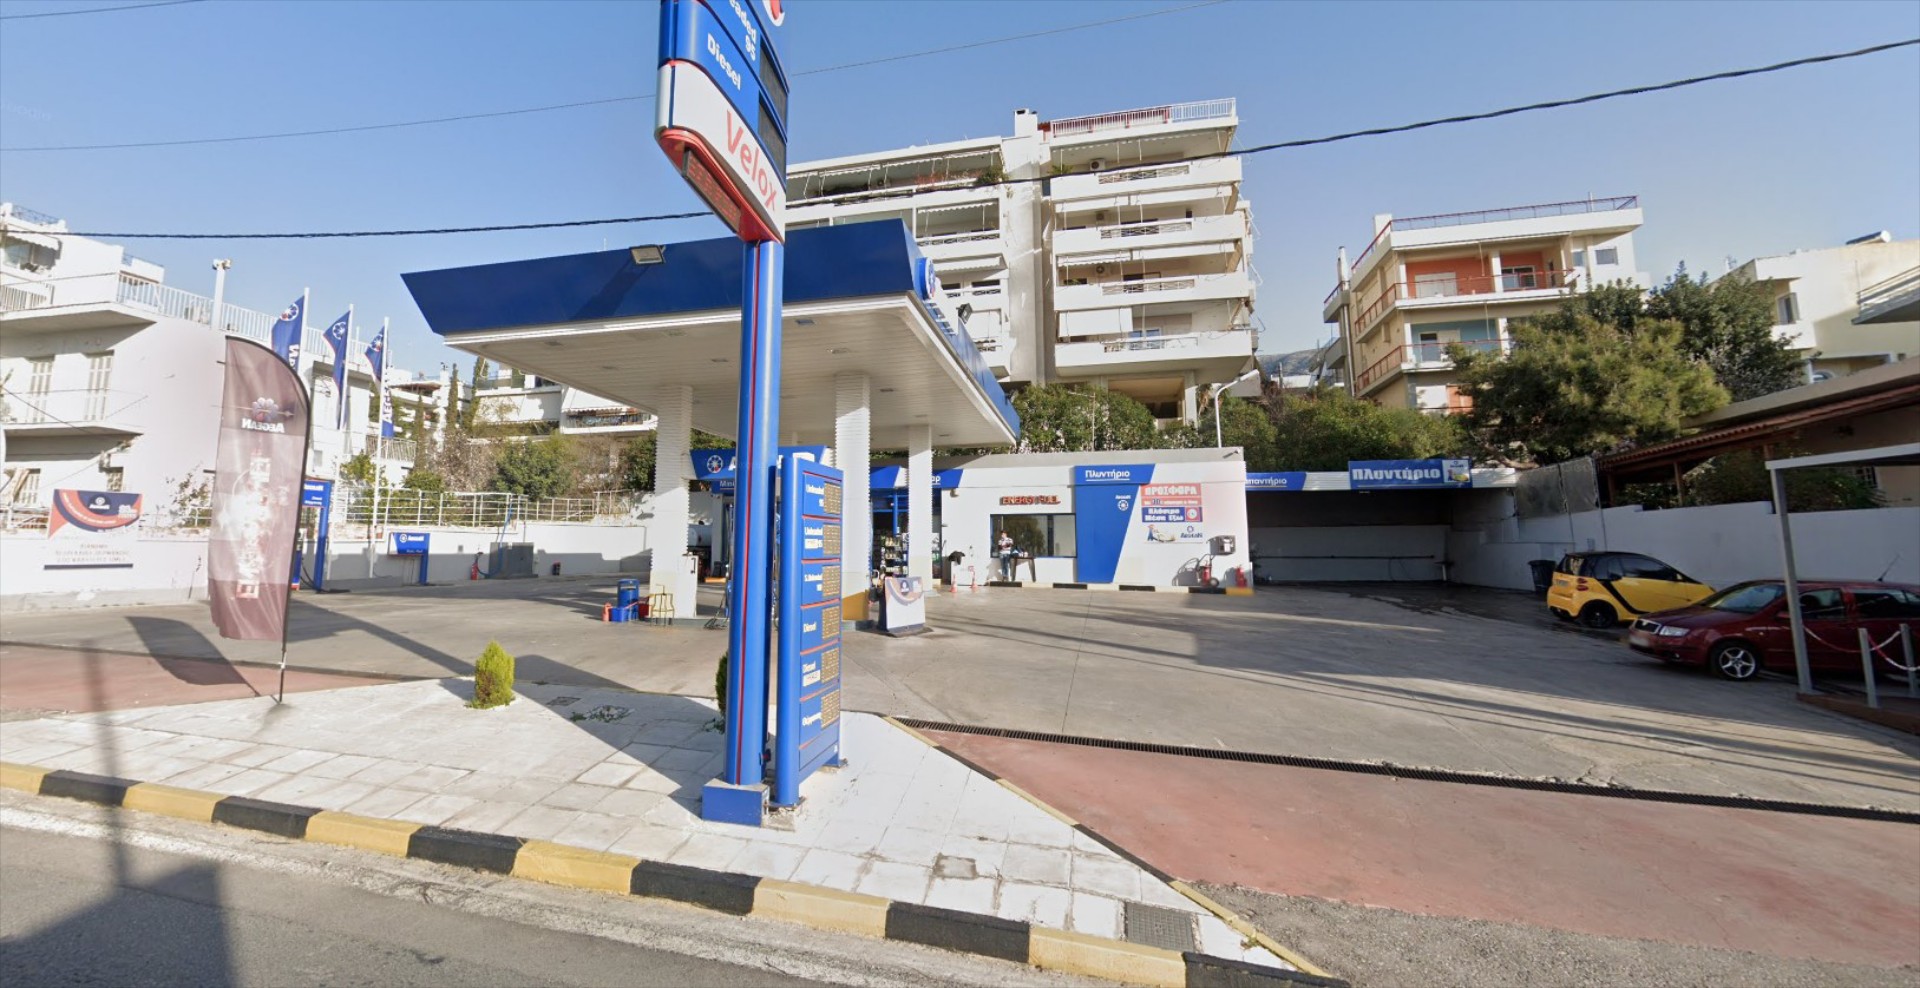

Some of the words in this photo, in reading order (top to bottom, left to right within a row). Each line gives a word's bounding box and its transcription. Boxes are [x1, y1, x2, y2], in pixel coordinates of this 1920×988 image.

[745, 34, 756, 61] 95
[707, 32, 740, 91] Diesel
[726, 109, 777, 212] Velox
[1085, 469, 1131, 480] Πλυντήριο
[1352, 467, 1441, 481] Πλυντήριο
